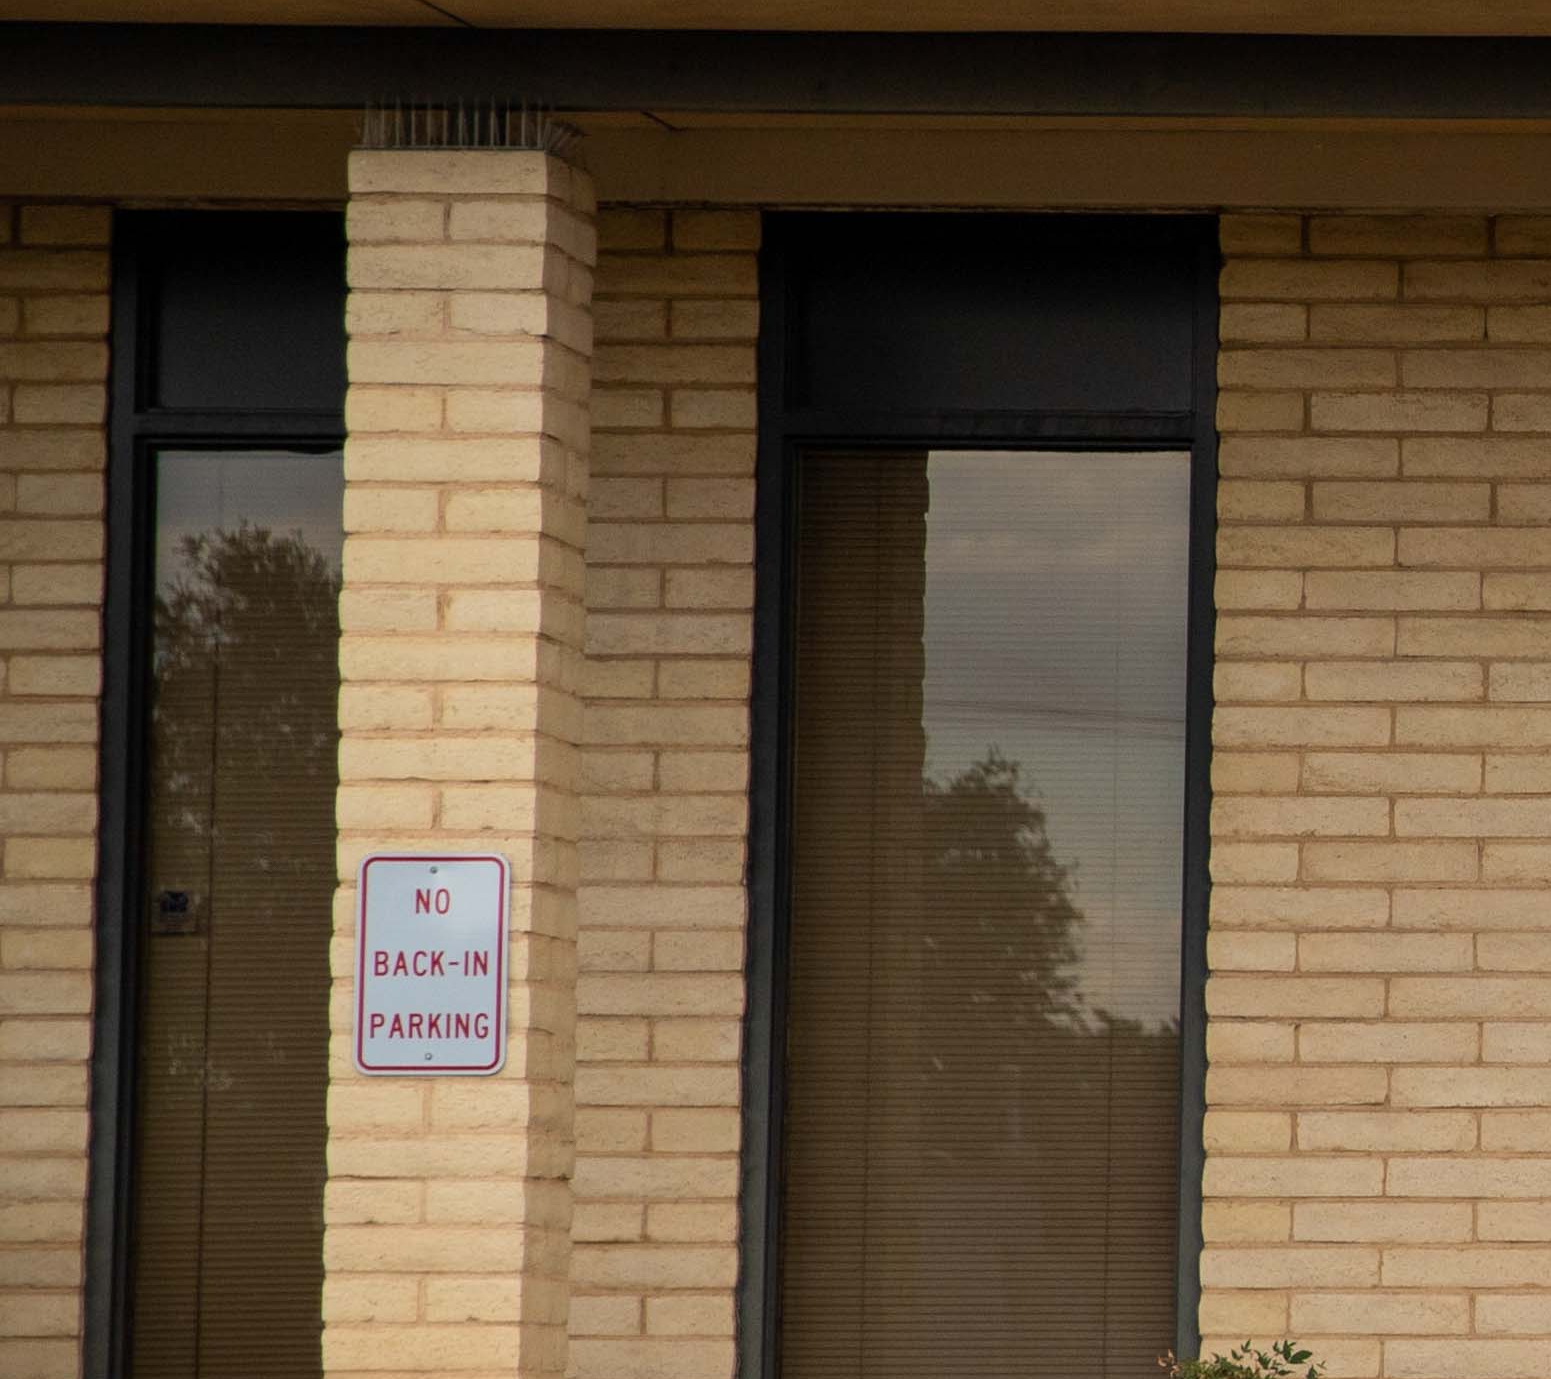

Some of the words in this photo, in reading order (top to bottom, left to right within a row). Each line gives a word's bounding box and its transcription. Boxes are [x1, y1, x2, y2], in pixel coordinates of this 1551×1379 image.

[415, 888, 450, 914] NO
[373, 950, 489, 977] BACK-IN
[369, 1012, 490, 1039] PARKING
